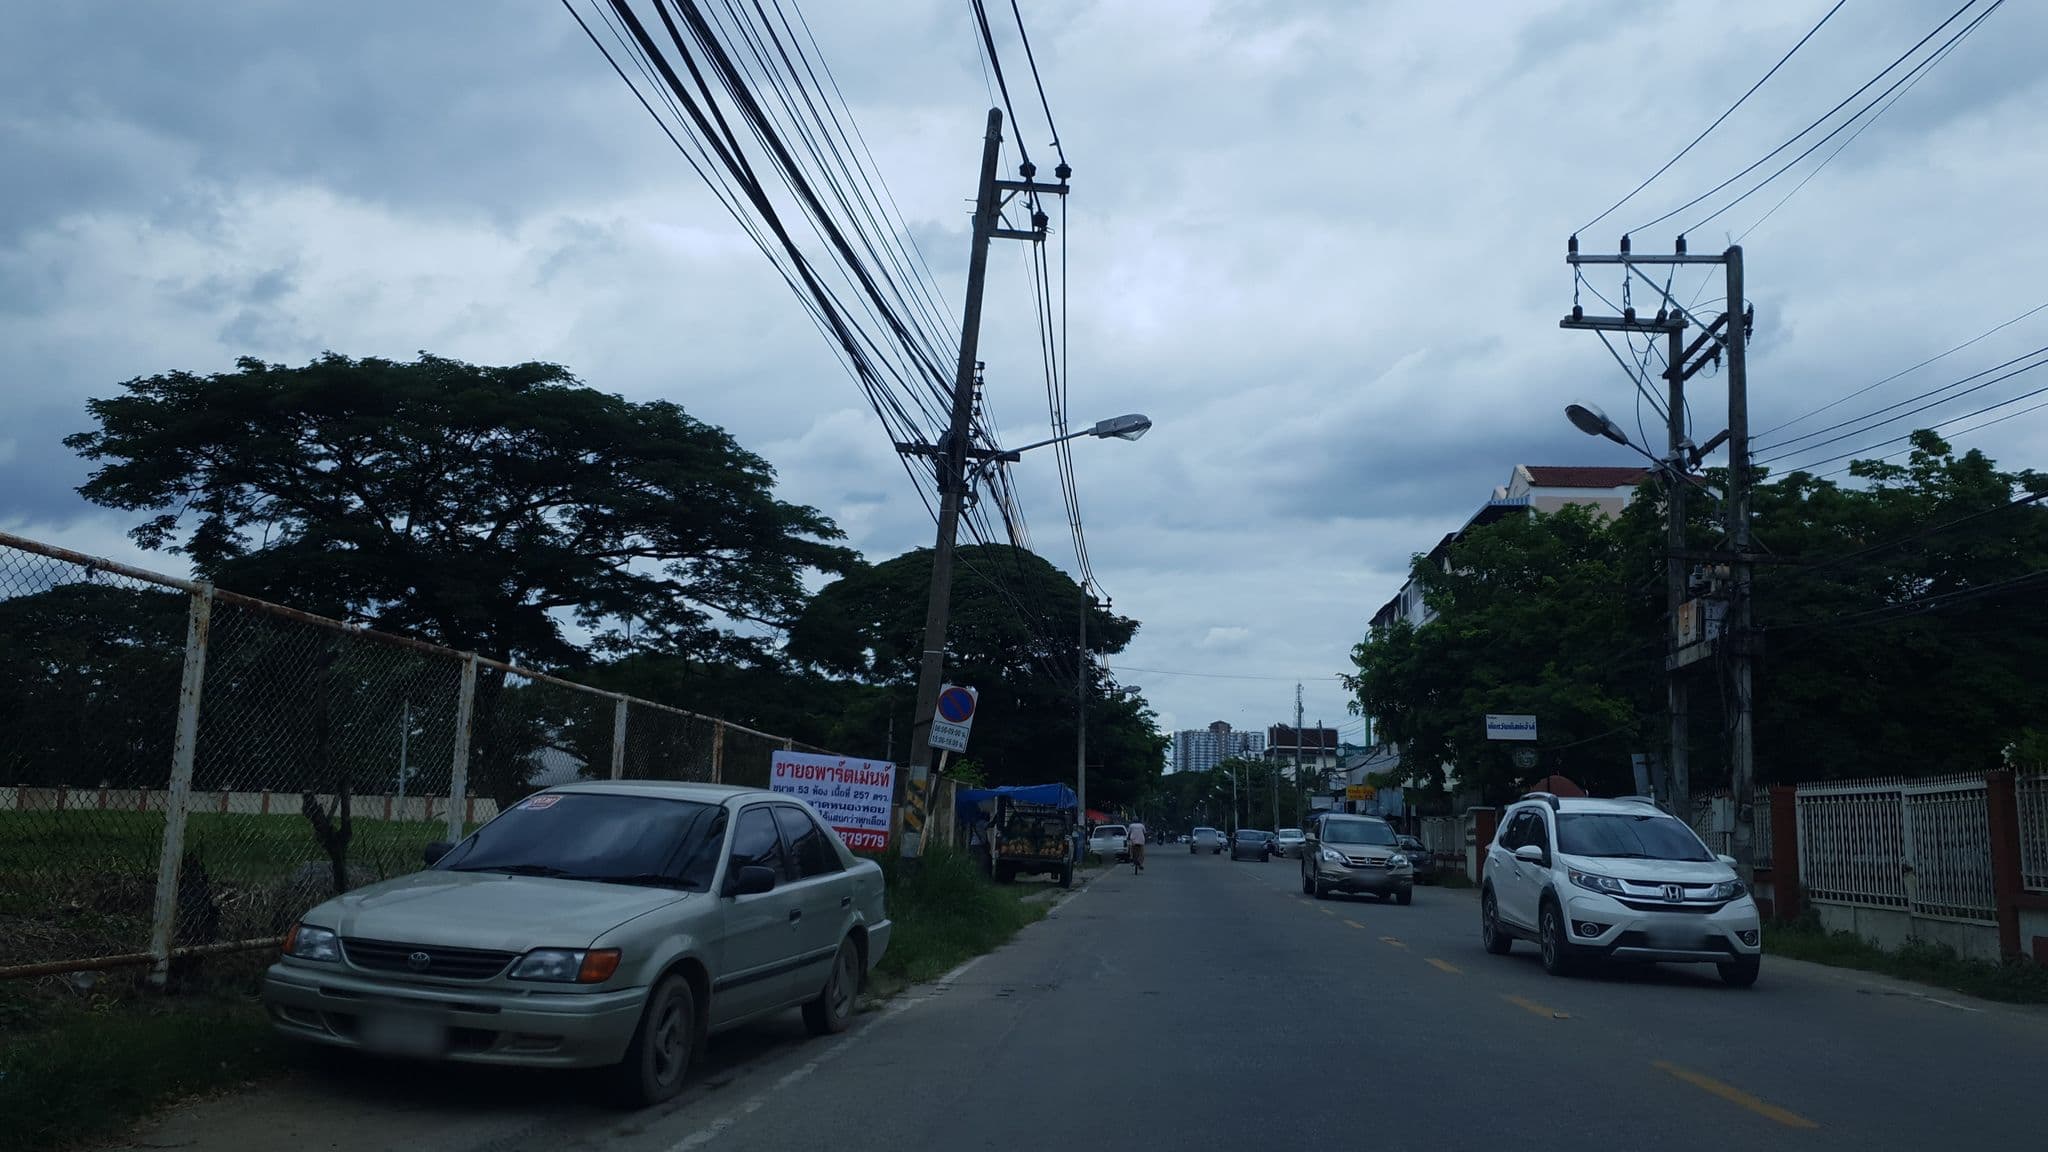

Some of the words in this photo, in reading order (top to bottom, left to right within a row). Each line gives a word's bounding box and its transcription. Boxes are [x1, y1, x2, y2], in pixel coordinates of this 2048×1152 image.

[776, 760, 892, 787] ขายอพาร์ตเม้นท์
[773, 785, 794, 793] ขนาด
[798, 785, 809, 794] 53
[813, 786, 828, 796] ห้อง
[831, 785, 851, 798] เนื้อที่
[853, 790, 870, 800] 257
